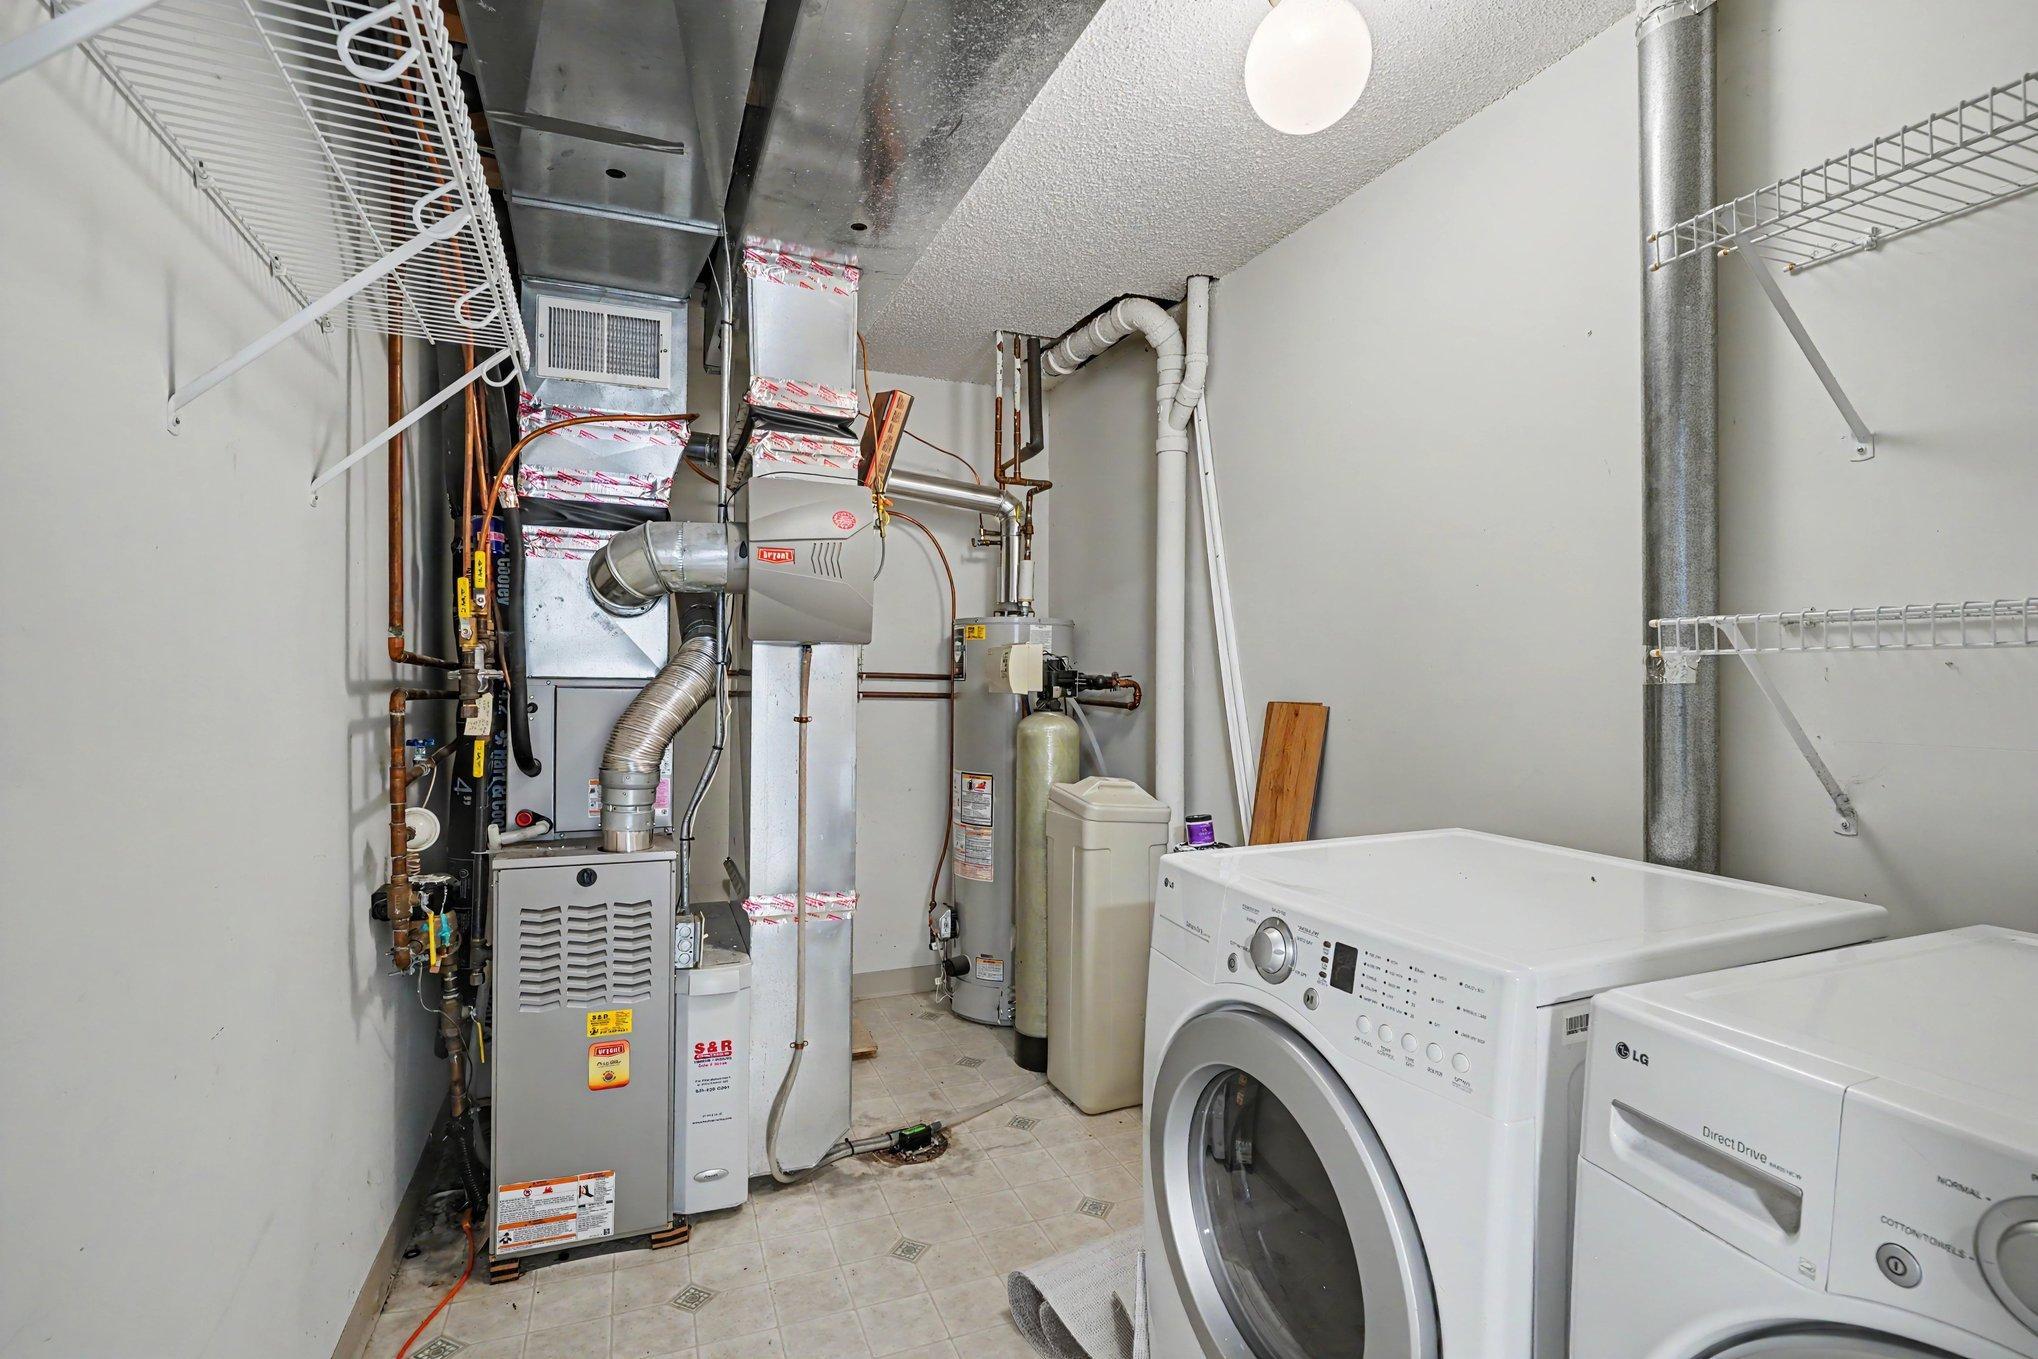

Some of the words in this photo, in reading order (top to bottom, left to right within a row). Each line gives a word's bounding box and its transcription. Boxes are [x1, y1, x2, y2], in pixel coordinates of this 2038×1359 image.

[763, 551, 789, 561] bryant
[497, 557, 511, 606] Cooley
[694, 1042, 705, 1054] S
[707, 1041, 718, 1053] &
[721, 1039, 732, 1052] R
[1632, 1050, 1649, 1067] LG
[1702, 1125, 1735, 1150] Direct
[1737, 1141, 1767, 1164] Drive
[1937, 1175, 1983, 1200] NORMAL
[1880, 1215, 1966, 1260] COTTON/TOWELS
